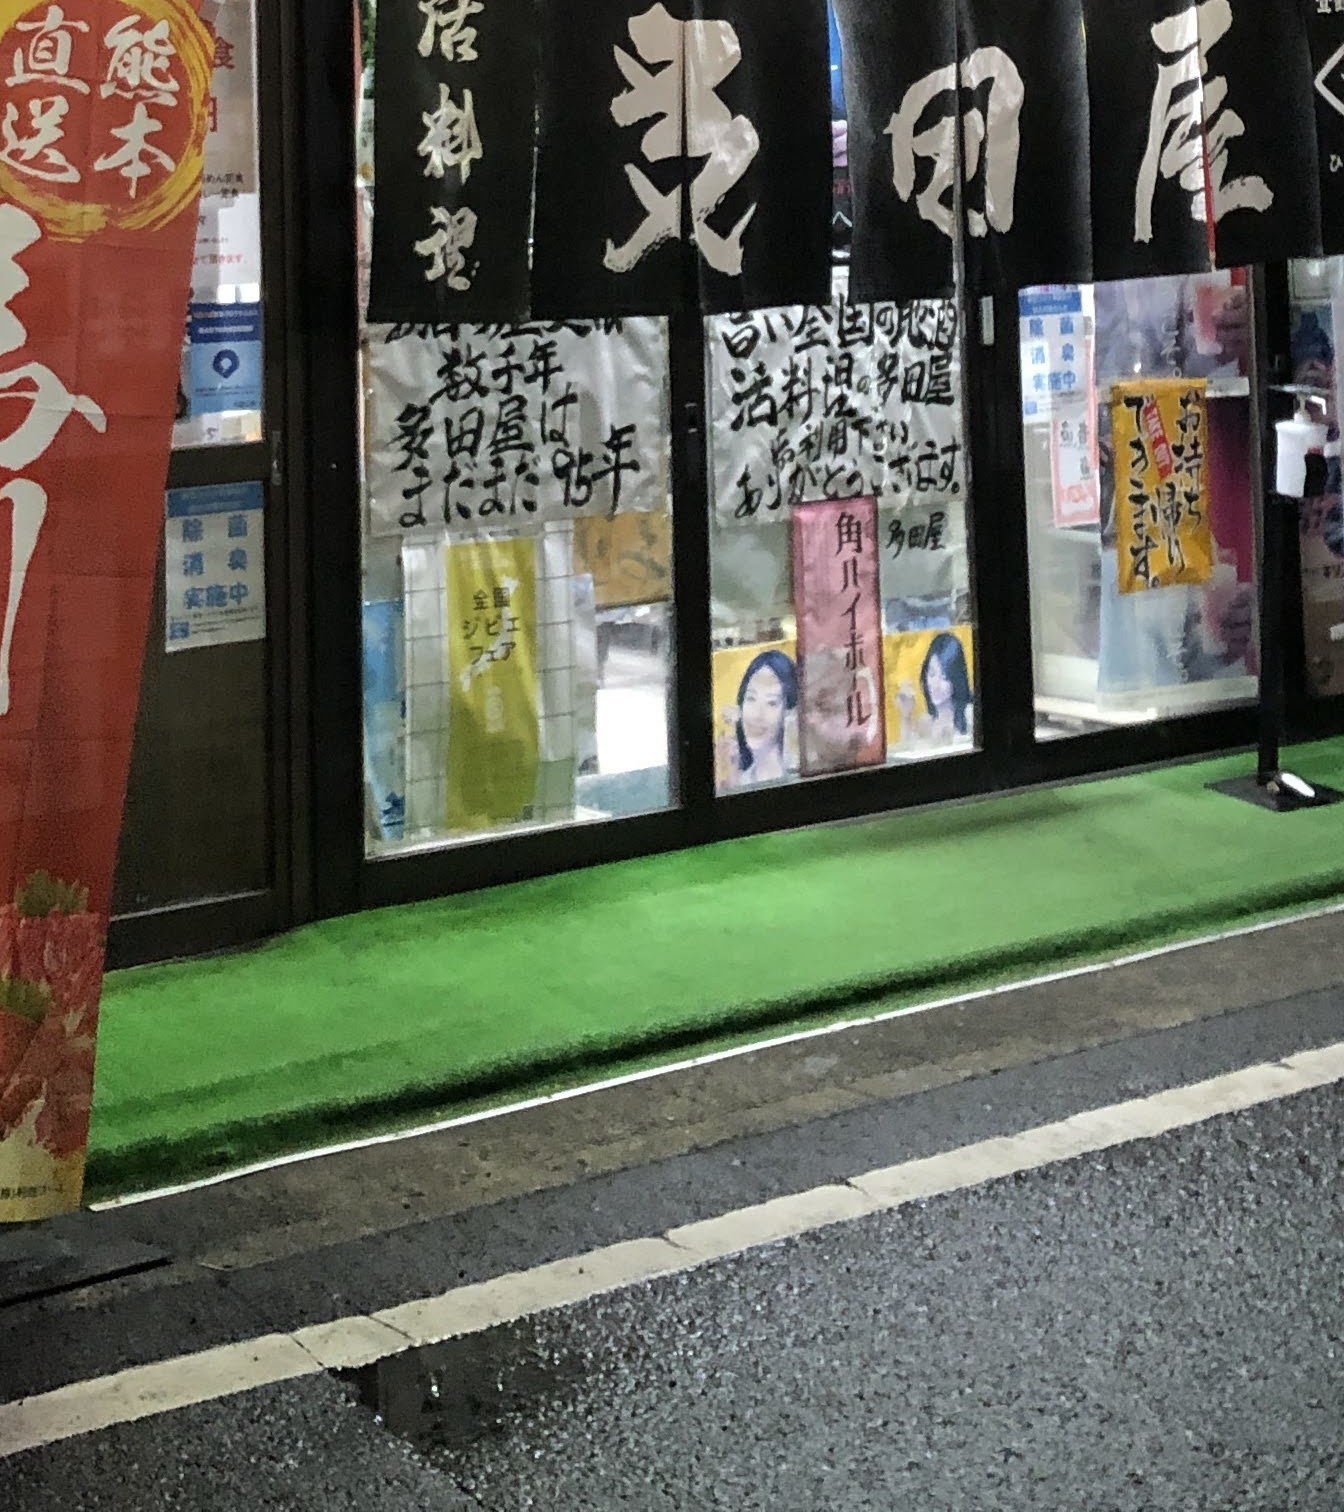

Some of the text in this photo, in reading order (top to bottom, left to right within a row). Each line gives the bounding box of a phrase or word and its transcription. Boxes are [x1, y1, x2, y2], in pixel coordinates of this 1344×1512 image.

[0, 4, 91, 185] 直送
[96, 11, 186, 200] 熊本
[430, 338, 565, 405] 数千年
[388, 382, 579, 472] 多田屋は
[462, 614, 521, 641] ジビエ
[472, 588, 511, 610] 全国
[832, 511, 870, 729] 角ハイボール
[468, 641, 517, 666] フェア
